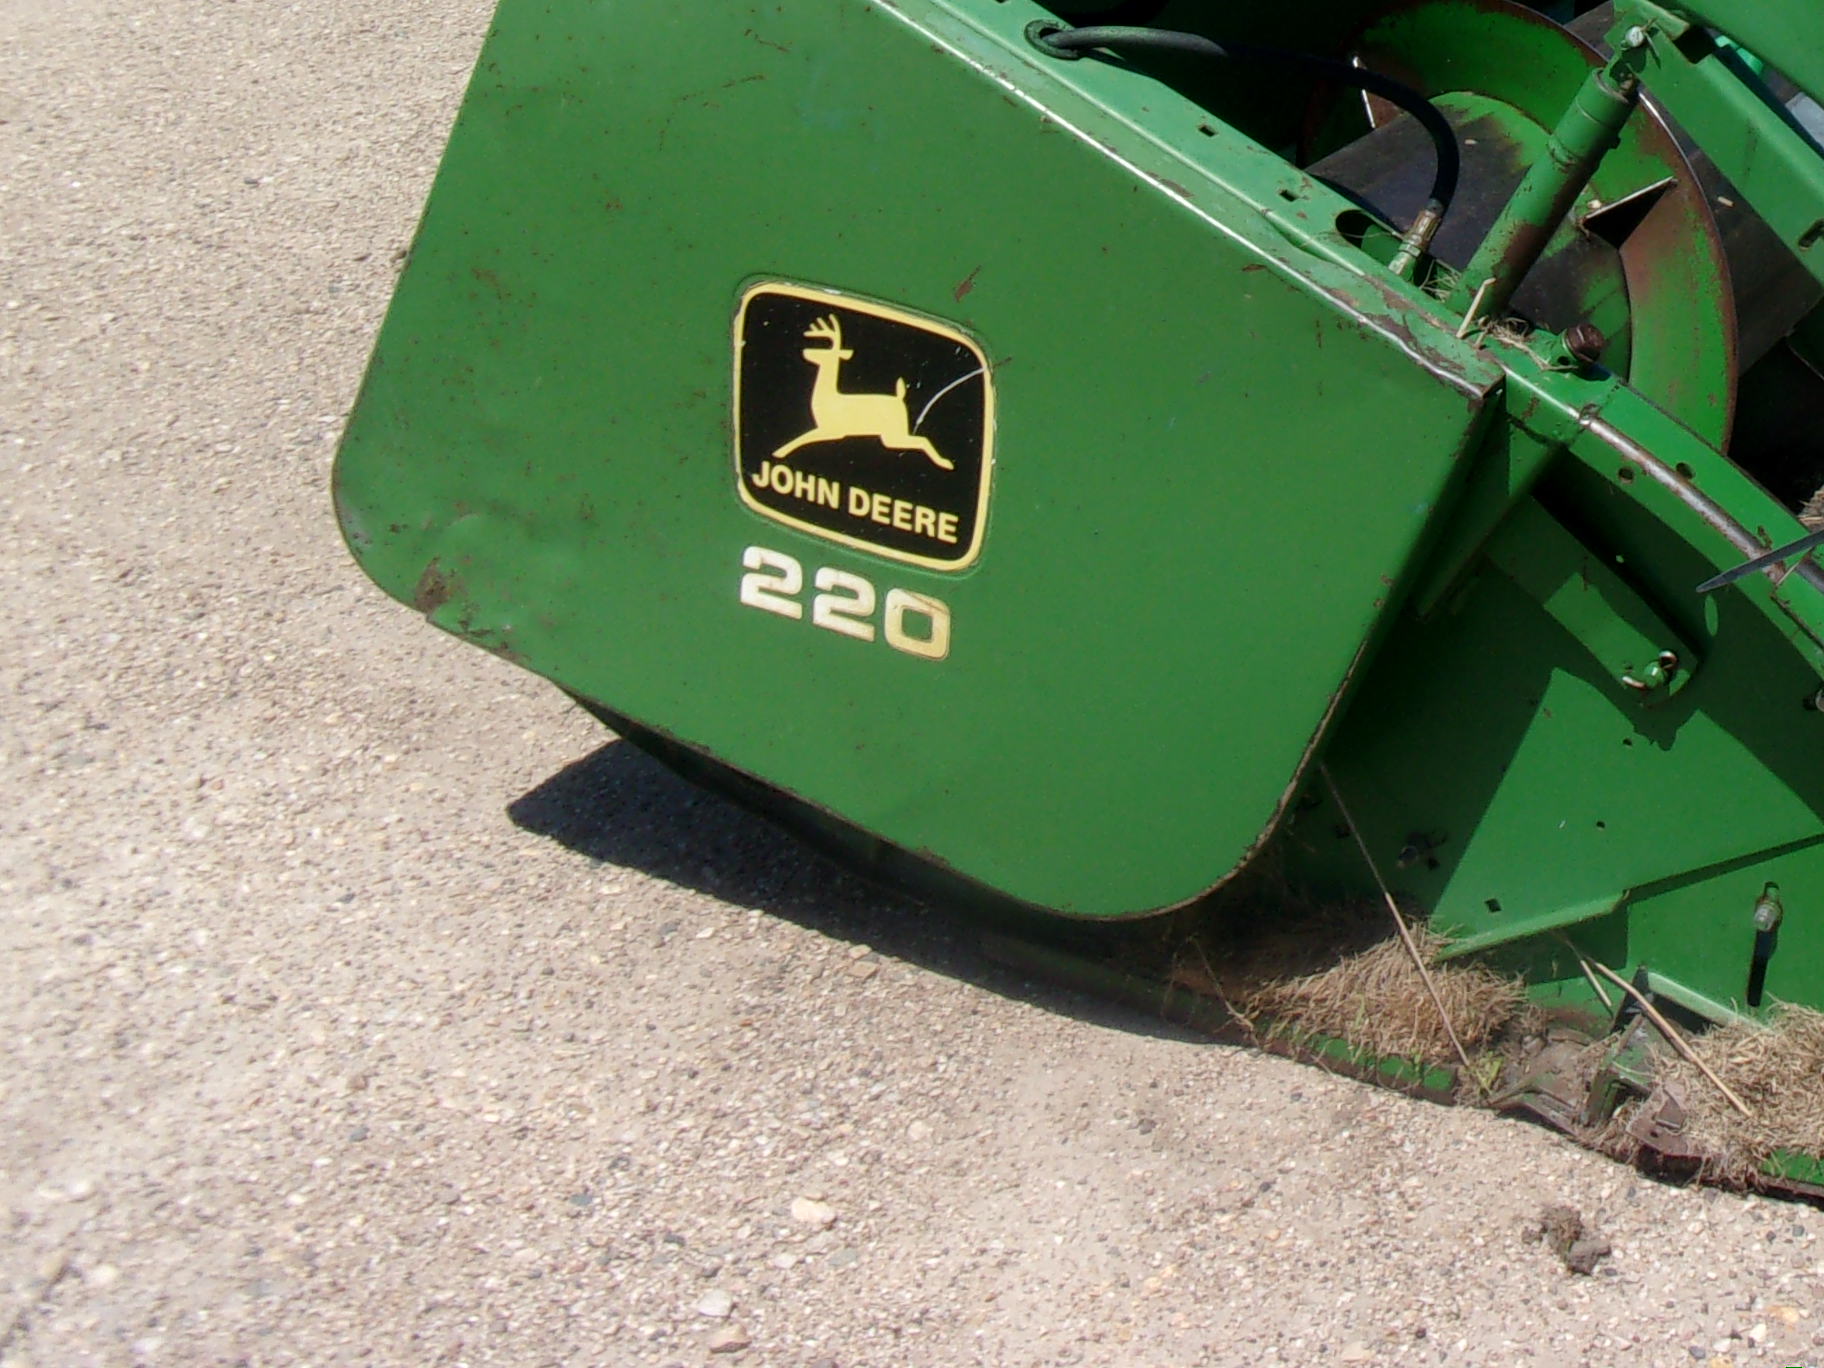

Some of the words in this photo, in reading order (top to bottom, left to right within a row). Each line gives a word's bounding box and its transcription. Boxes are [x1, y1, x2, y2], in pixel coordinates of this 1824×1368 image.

[752, 461, 840, 509] JOHN
[848, 486, 959, 544] DEERE
[740, 545, 950, 660] 220
